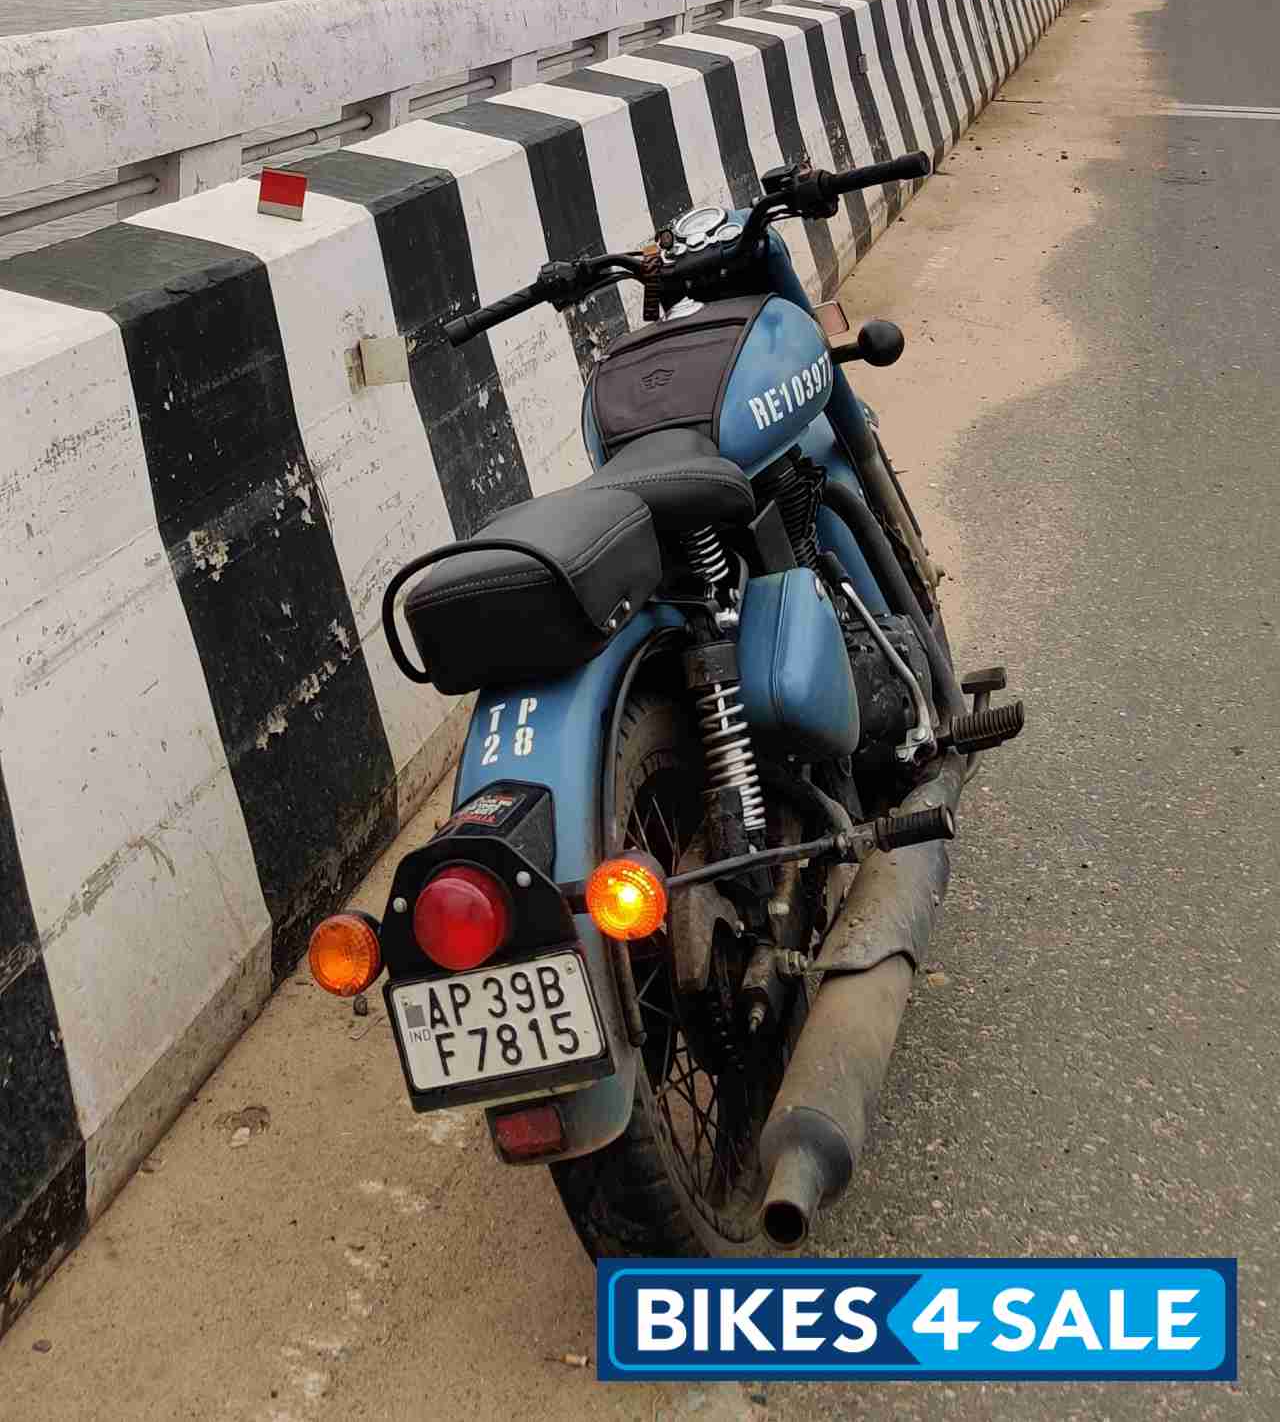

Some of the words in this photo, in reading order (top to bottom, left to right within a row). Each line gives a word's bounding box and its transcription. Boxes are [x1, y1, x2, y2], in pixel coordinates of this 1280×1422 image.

[427, 983, 472, 1029] AP
[482, 966, 565, 1019] 39B
[408, 1028, 431, 1043] IND
